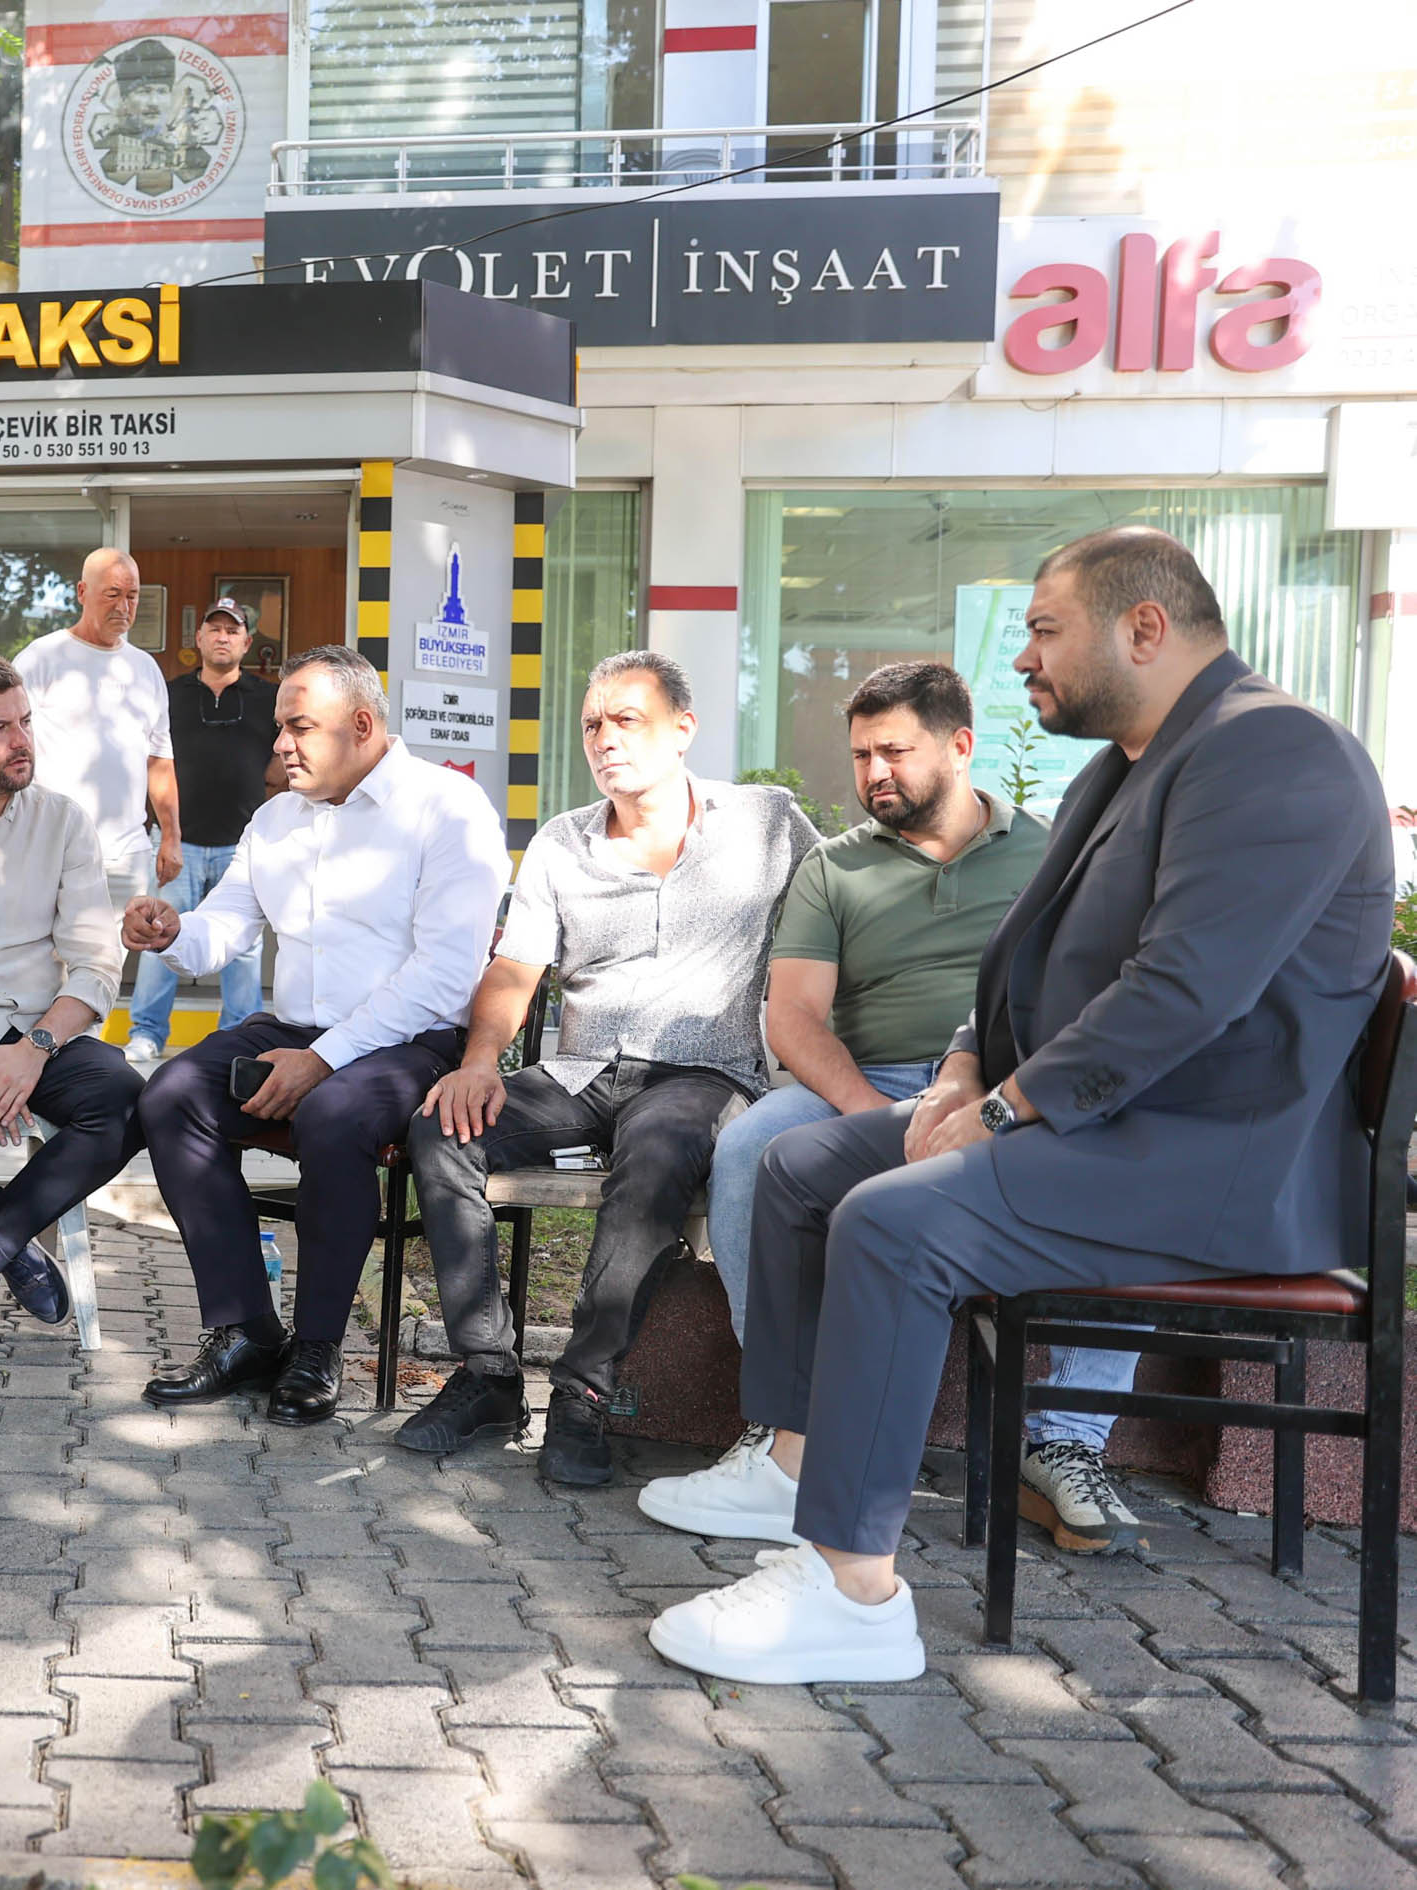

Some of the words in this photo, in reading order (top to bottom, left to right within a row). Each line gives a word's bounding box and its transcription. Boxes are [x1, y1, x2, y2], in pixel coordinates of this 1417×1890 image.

[301, 245, 631, 298] EVOLET
[683, 238, 960, 305] İNŞAAT
[1004, 230, 1322, 376] alfa
[66, 410, 103, 437] BİR
[110, 407, 176, 435] TAKSİ
[3, 445, 19, 458] 50
[34, 444, 41, 457] 0
[47, 443, 73, 457] 530
[78, 442, 104, 456] 551
[110, 442, 127, 455] 90
[132, 441, 150, 455] 13
[438, 624, 468, 640] İZMİR
[405, 706, 437, 721] ŞOFÖRLER
[439, 711, 447, 722] VE
[431, 728, 449, 740] ESNAF
[451, 730, 469, 742] ODASI
